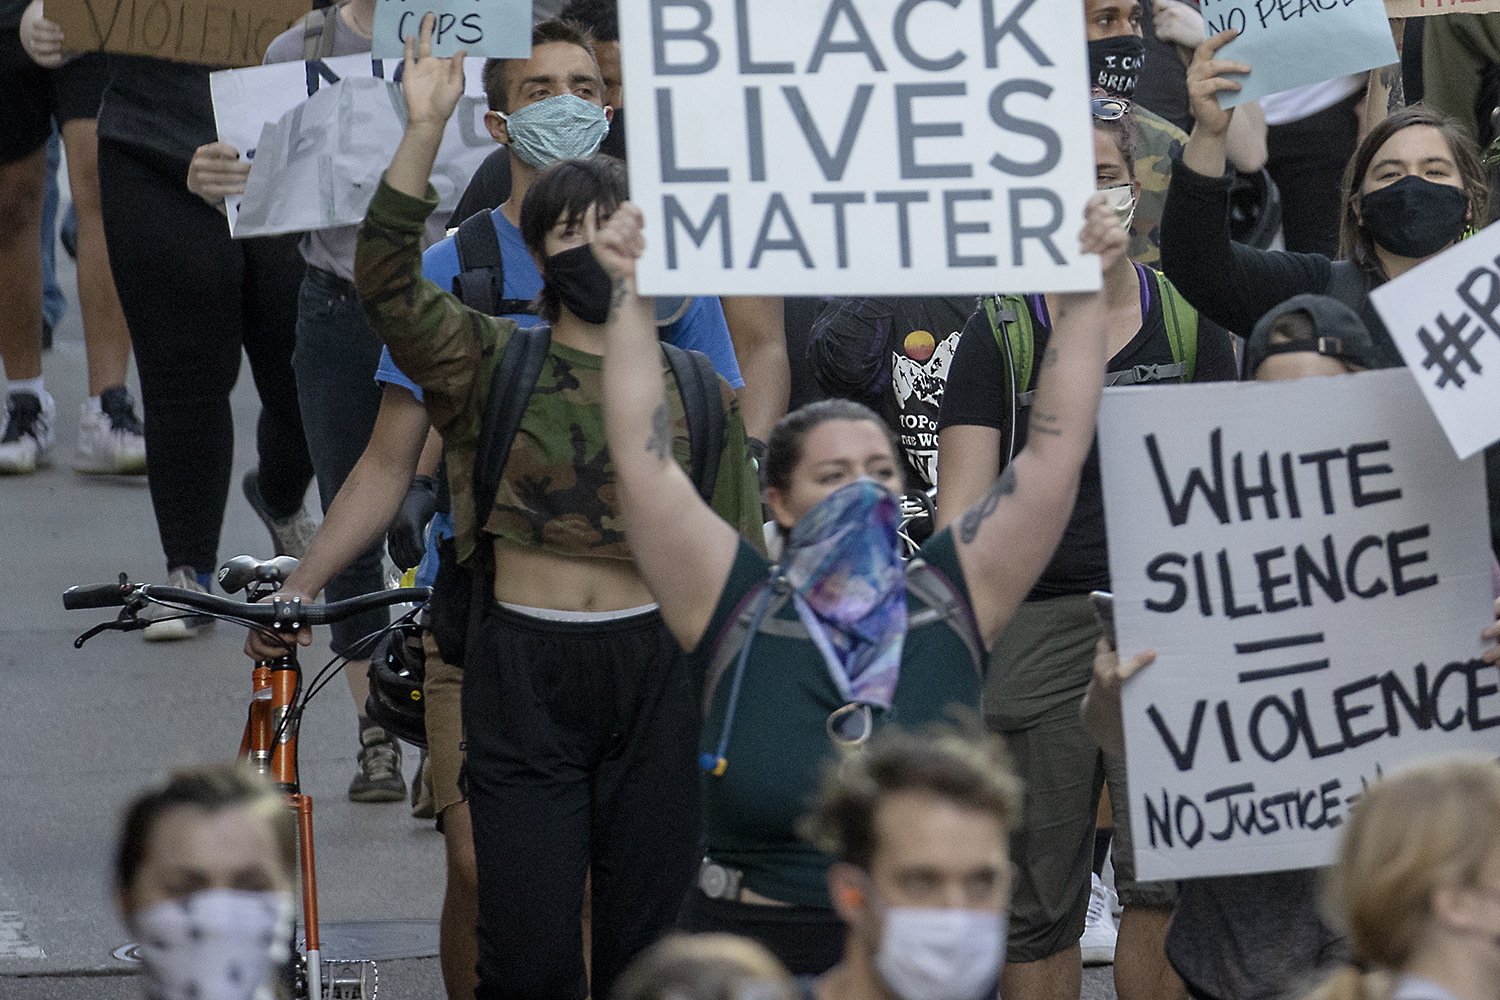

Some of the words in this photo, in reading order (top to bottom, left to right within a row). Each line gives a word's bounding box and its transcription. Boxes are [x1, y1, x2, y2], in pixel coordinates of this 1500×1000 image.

[398, 10, 484, 45] COPS
[1207, 7, 1247, 37] NO
[1105, 55, 1117, 69] I
[653, 77, 1065, 185] LIVES
[660, 185, 1071, 272] MATTER
[1143, 427, 1403, 528] WHITE
[1143, 522, 1440, 620] SILENCE
[1143, 786, 1205, 850] NO
